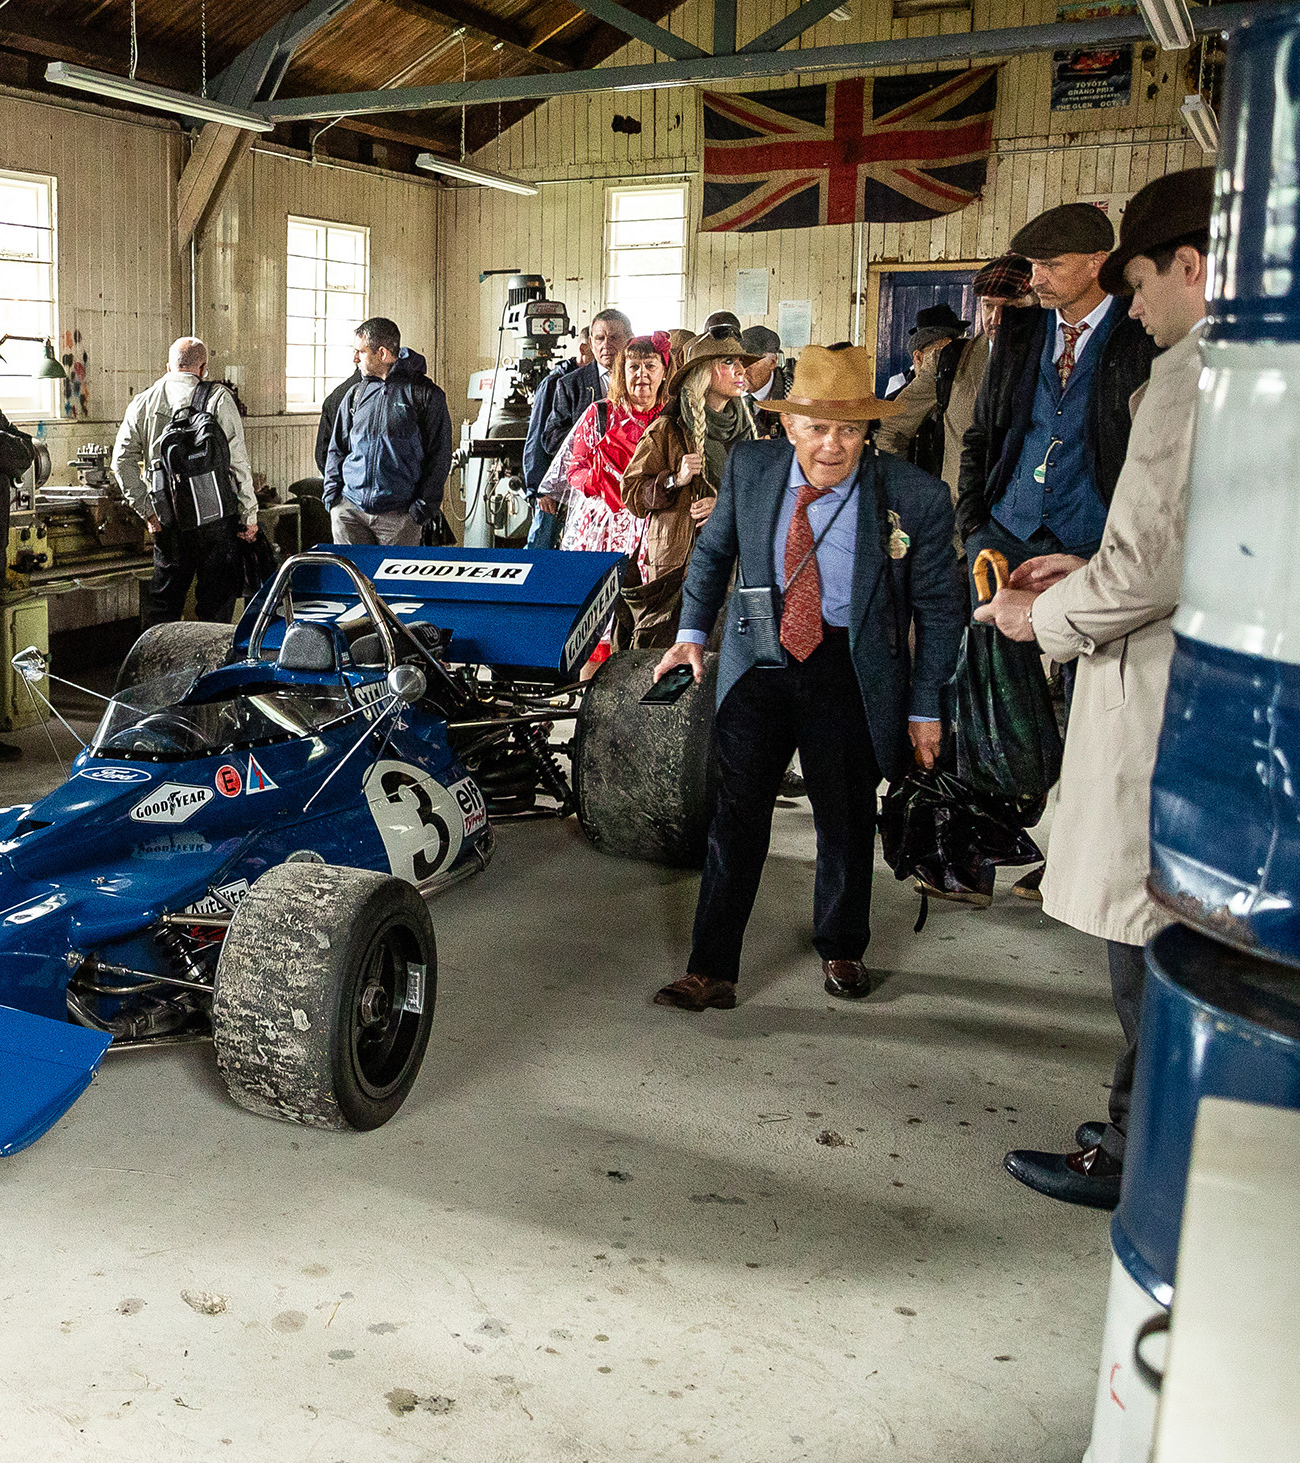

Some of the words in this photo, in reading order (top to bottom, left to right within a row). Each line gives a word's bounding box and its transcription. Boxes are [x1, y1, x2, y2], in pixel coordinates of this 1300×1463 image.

[1067, 88, 1095, 96] GRAND
[383, 563, 524, 580] GOODYEAR
[568, 575, 617, 661] GOODYEAR
[91, 767, 139, 781] Ford
[222, 770, 236, 793] E
[136, 789, 206, 819] GOODYEAR
[455, 780, 481, 815] elf
[381, 770, 451, 881] 3
